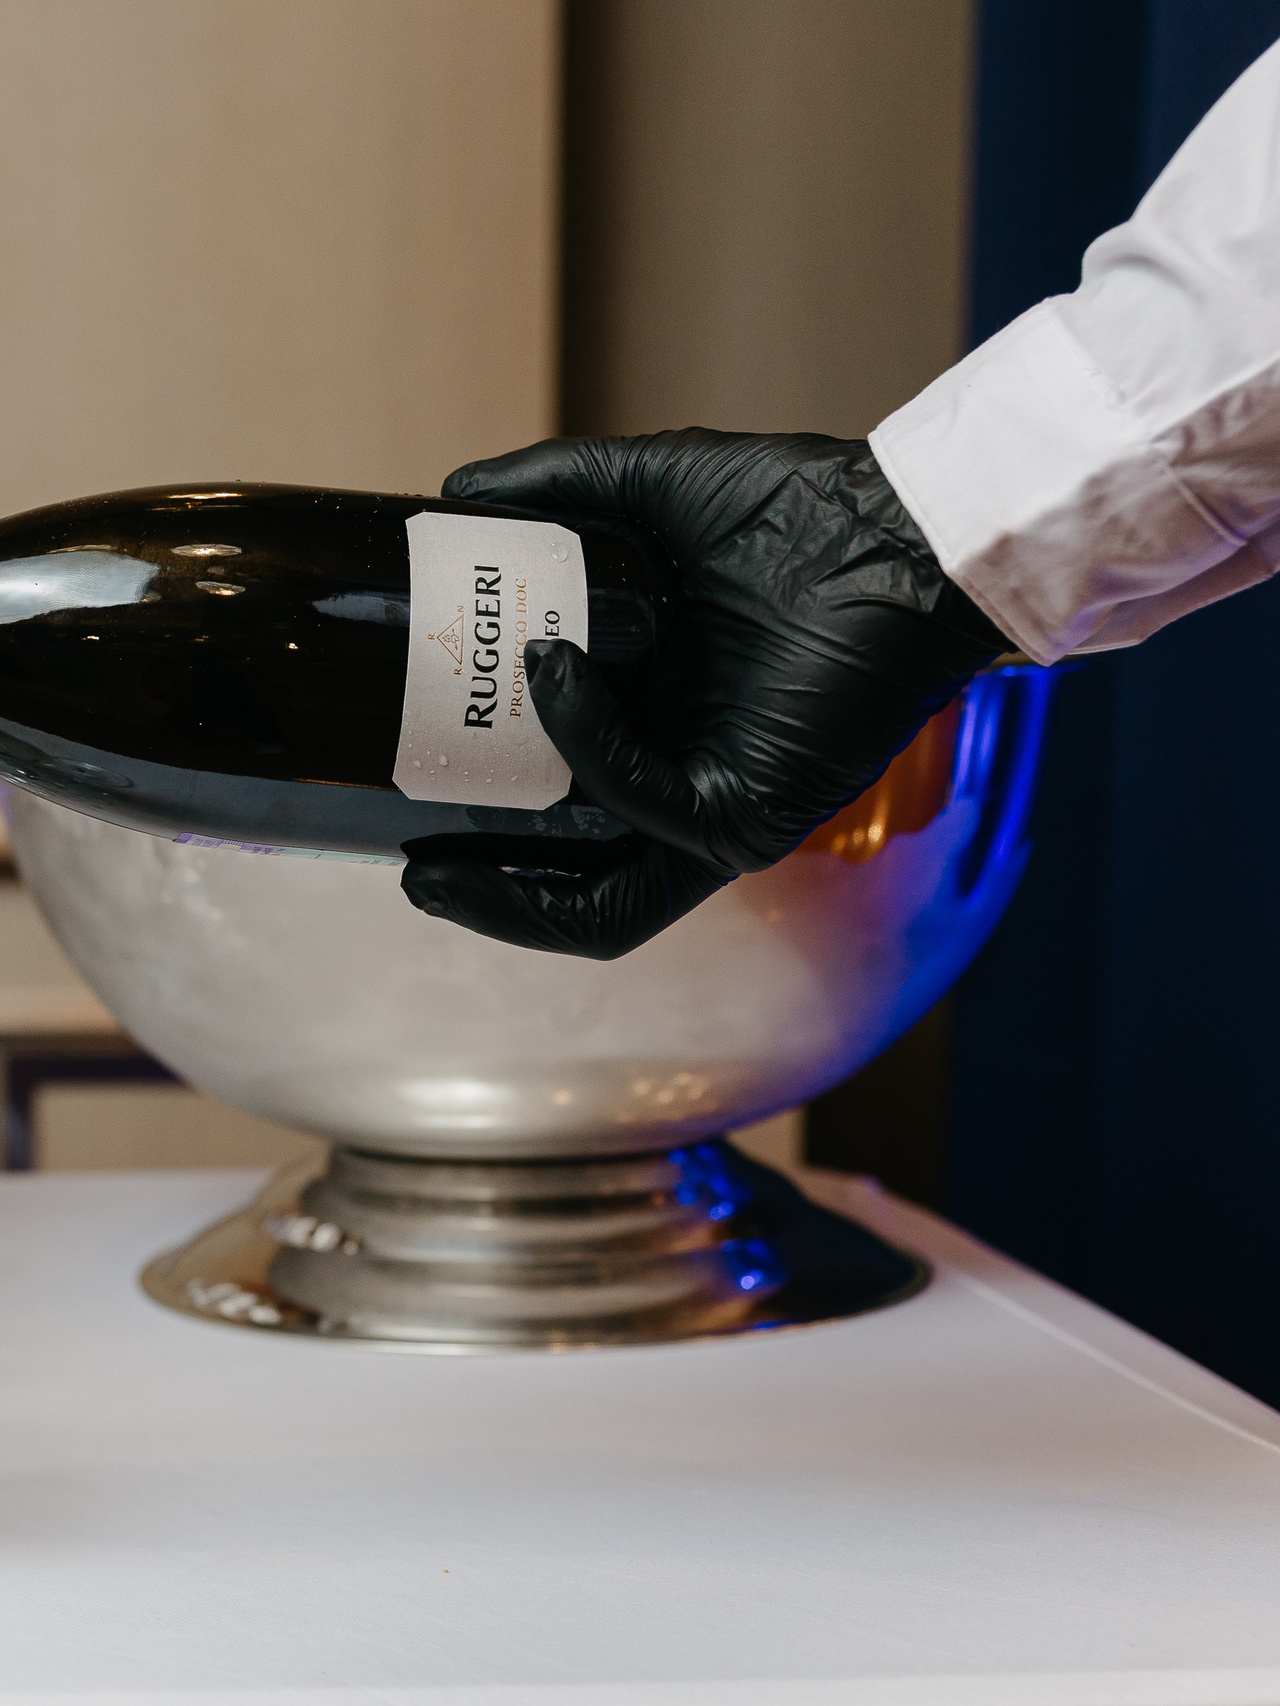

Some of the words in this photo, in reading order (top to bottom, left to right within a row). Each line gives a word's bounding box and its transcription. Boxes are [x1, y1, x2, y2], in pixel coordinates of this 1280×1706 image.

[515, 578, 527, 614] DOC
[457, 605, 464, 613] N
[428, 632, 436, 640] R
[464, 565, 502, 729] RUGGERI
[454, 668, 462, 676] R
[509, 621, 527, 717] PROSECCO
